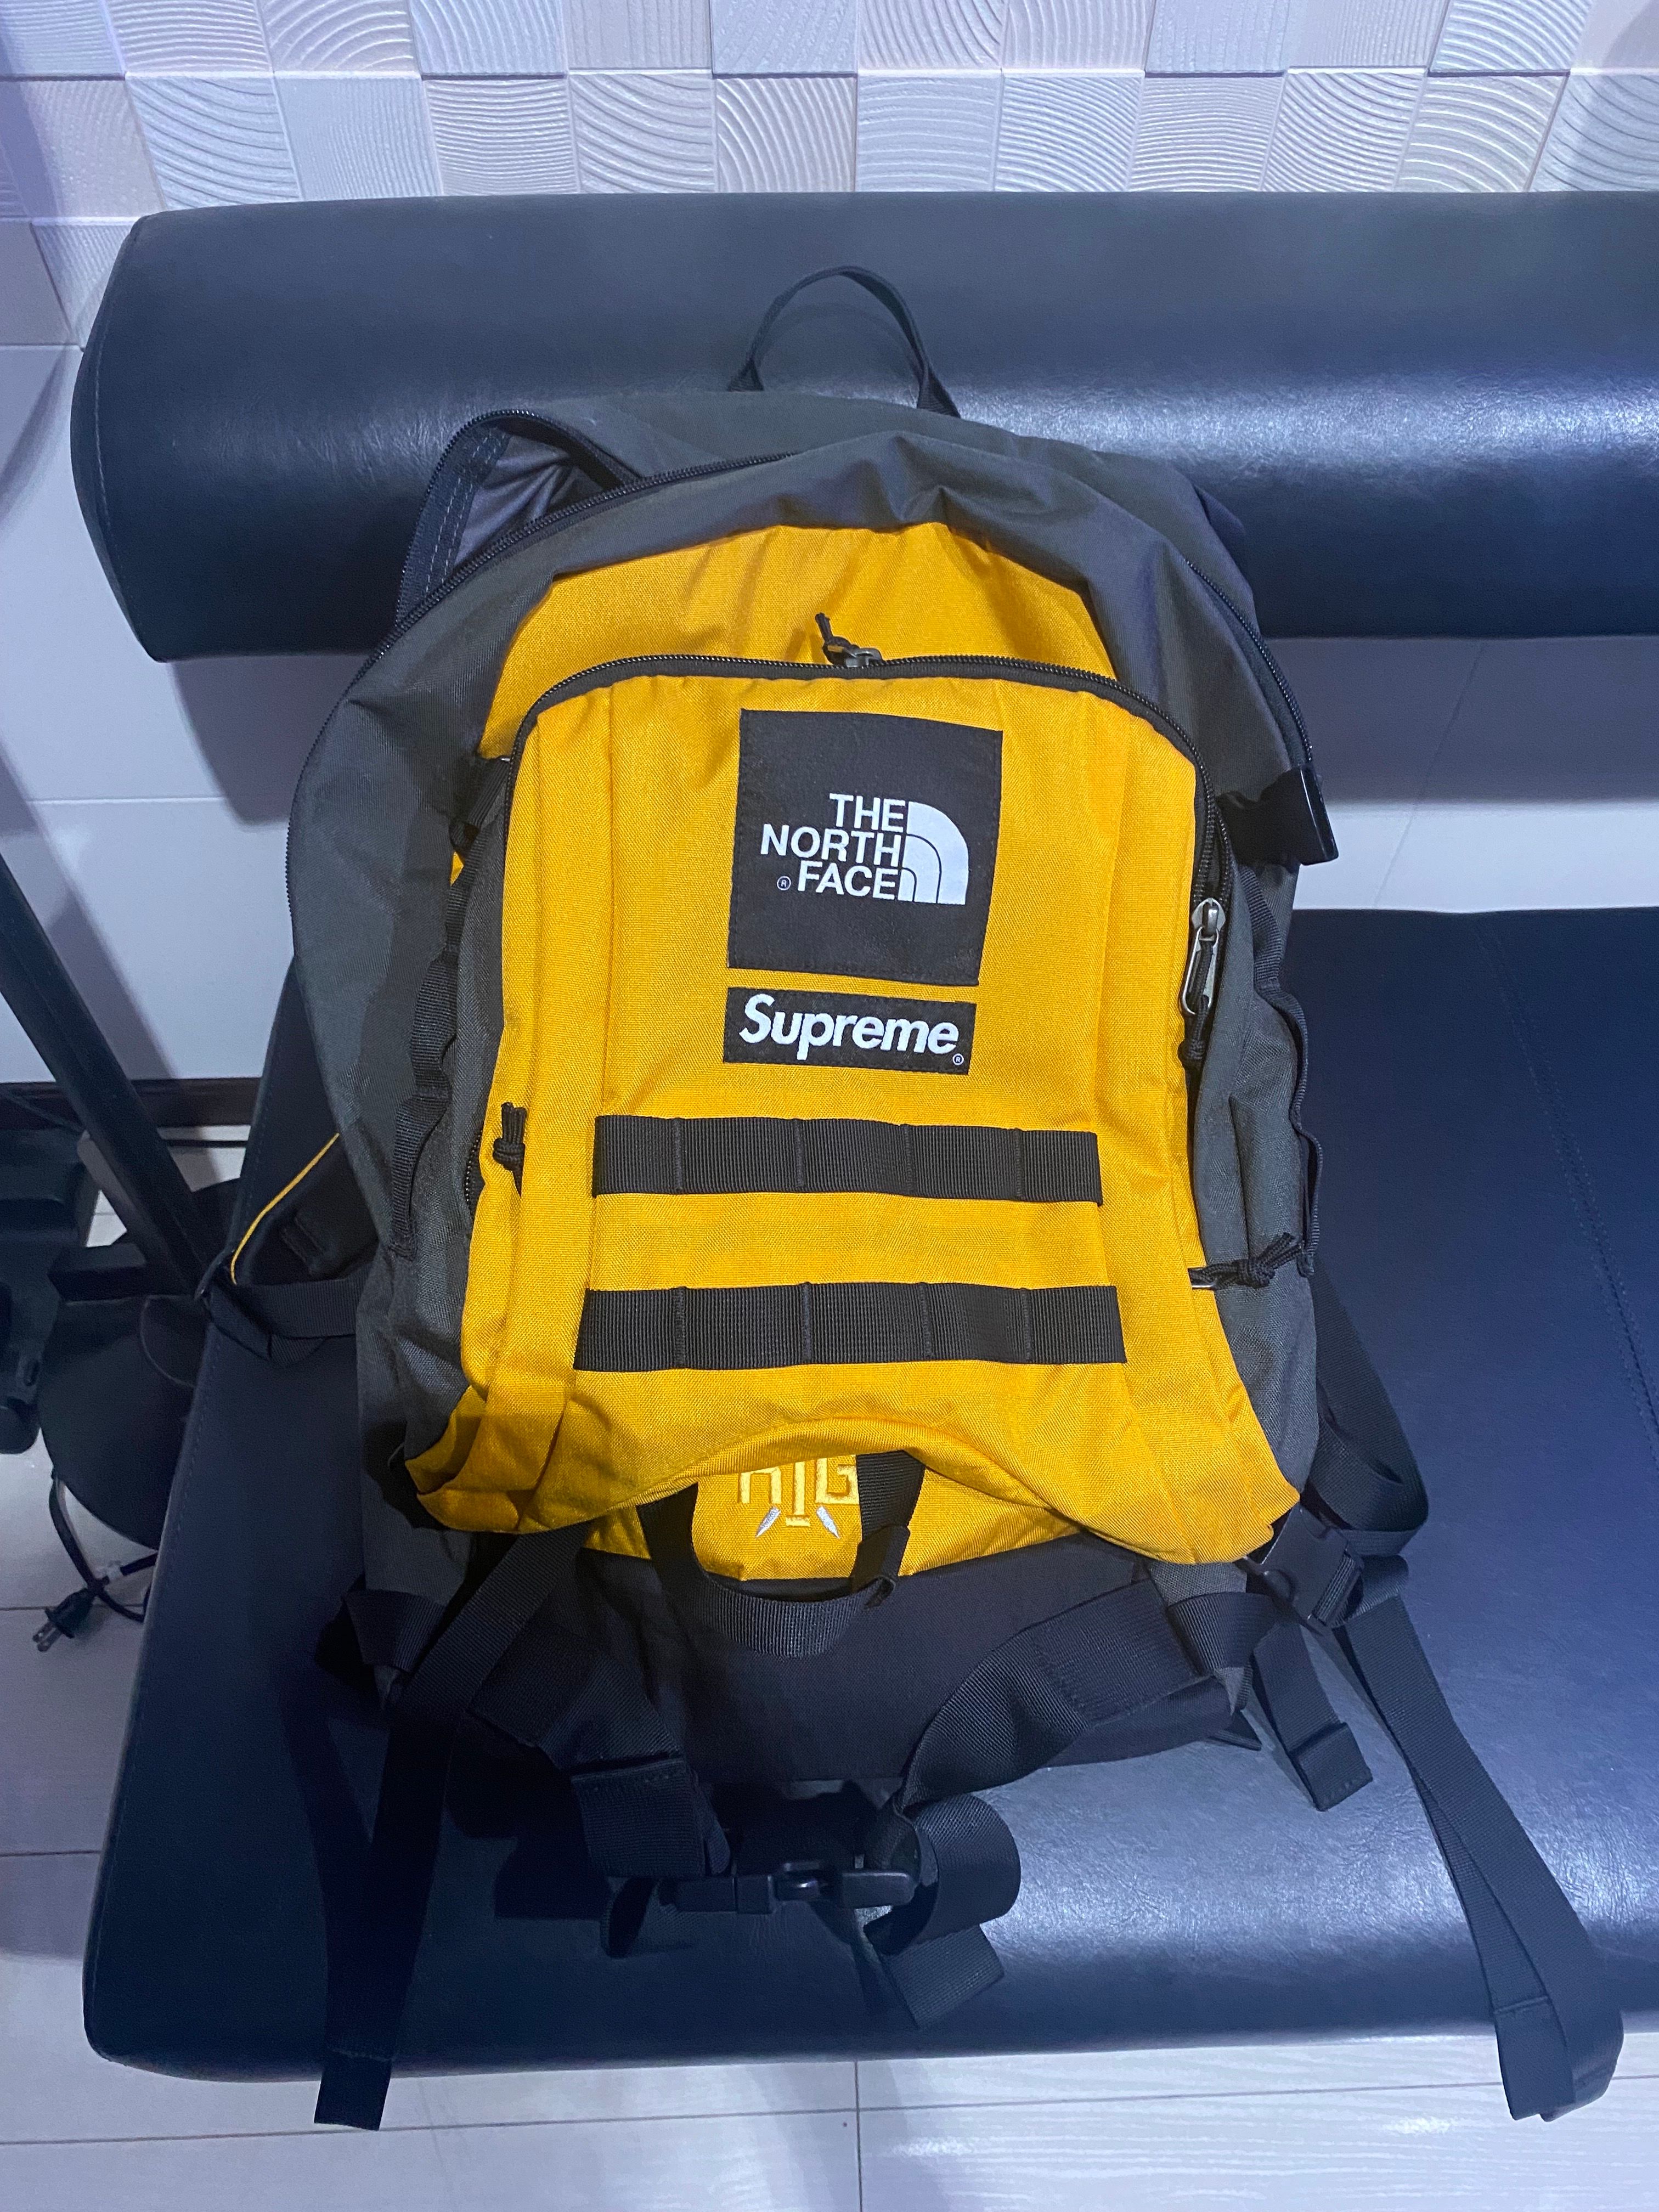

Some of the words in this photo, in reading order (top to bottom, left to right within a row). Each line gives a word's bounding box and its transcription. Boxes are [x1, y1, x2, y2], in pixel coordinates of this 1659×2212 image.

[829, 793, 906, 833] THE
[760, 823, 902, 867] NORTH
[797, 860, 899, 900] FACE
[738, 993, 959, 1060] Supreme
